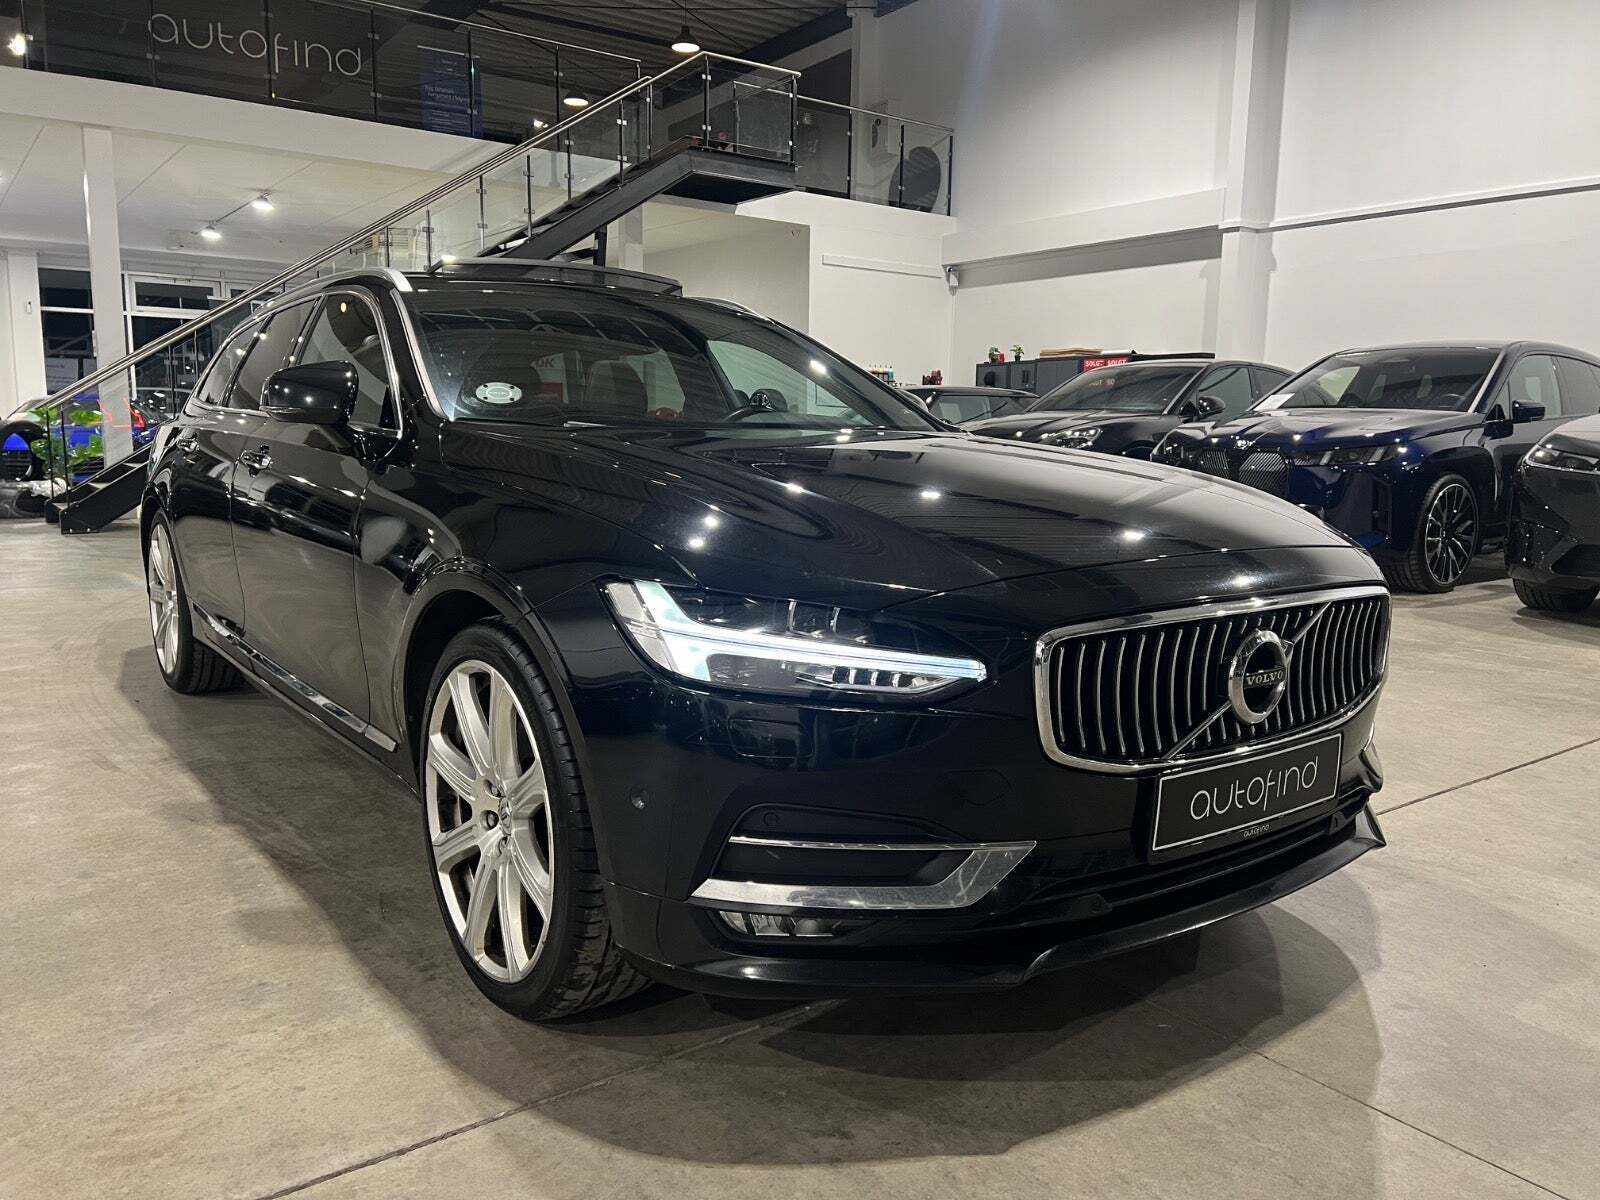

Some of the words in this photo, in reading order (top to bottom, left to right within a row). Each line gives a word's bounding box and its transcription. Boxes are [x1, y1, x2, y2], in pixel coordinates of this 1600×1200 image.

[147, 13, 361, 76] autofind
[1246, 670, 1283, 685] VOLVO
[1190, 755, 1318, 820] autofind
